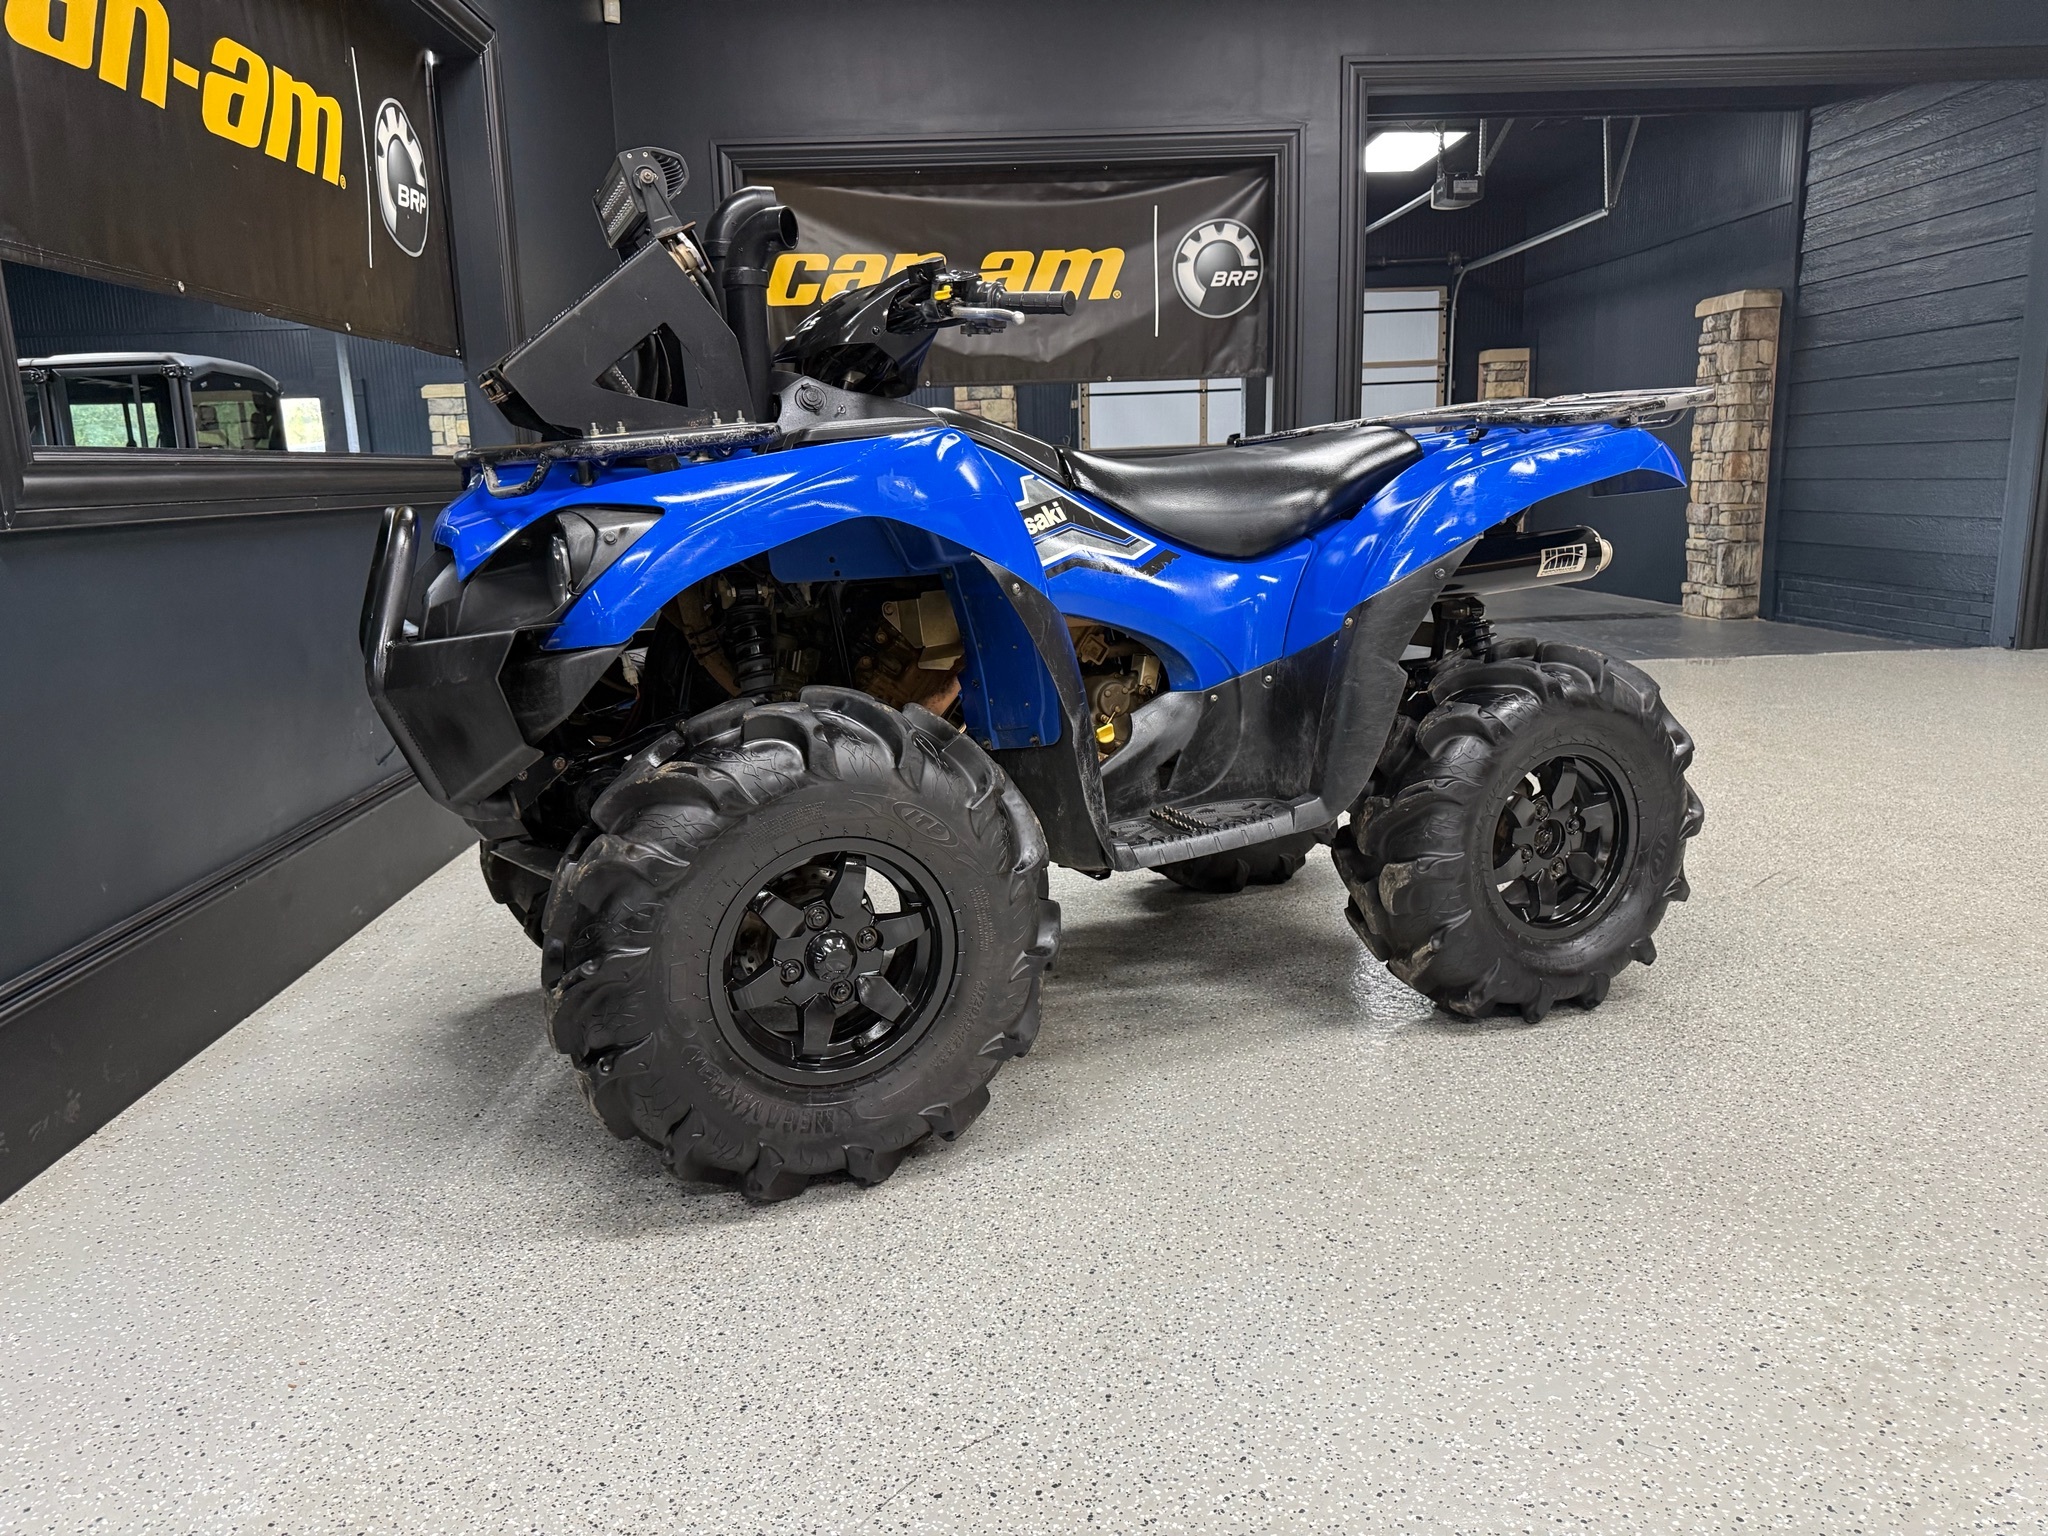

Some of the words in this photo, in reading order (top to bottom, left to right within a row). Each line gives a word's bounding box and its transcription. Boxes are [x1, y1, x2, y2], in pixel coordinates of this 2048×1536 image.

[397, 183, 427, 215] BRP
[1210, 270, 1259, 287] BRP
[1023, 501, 1068, 536] saki
[904, 809, 946, 836] ITP
